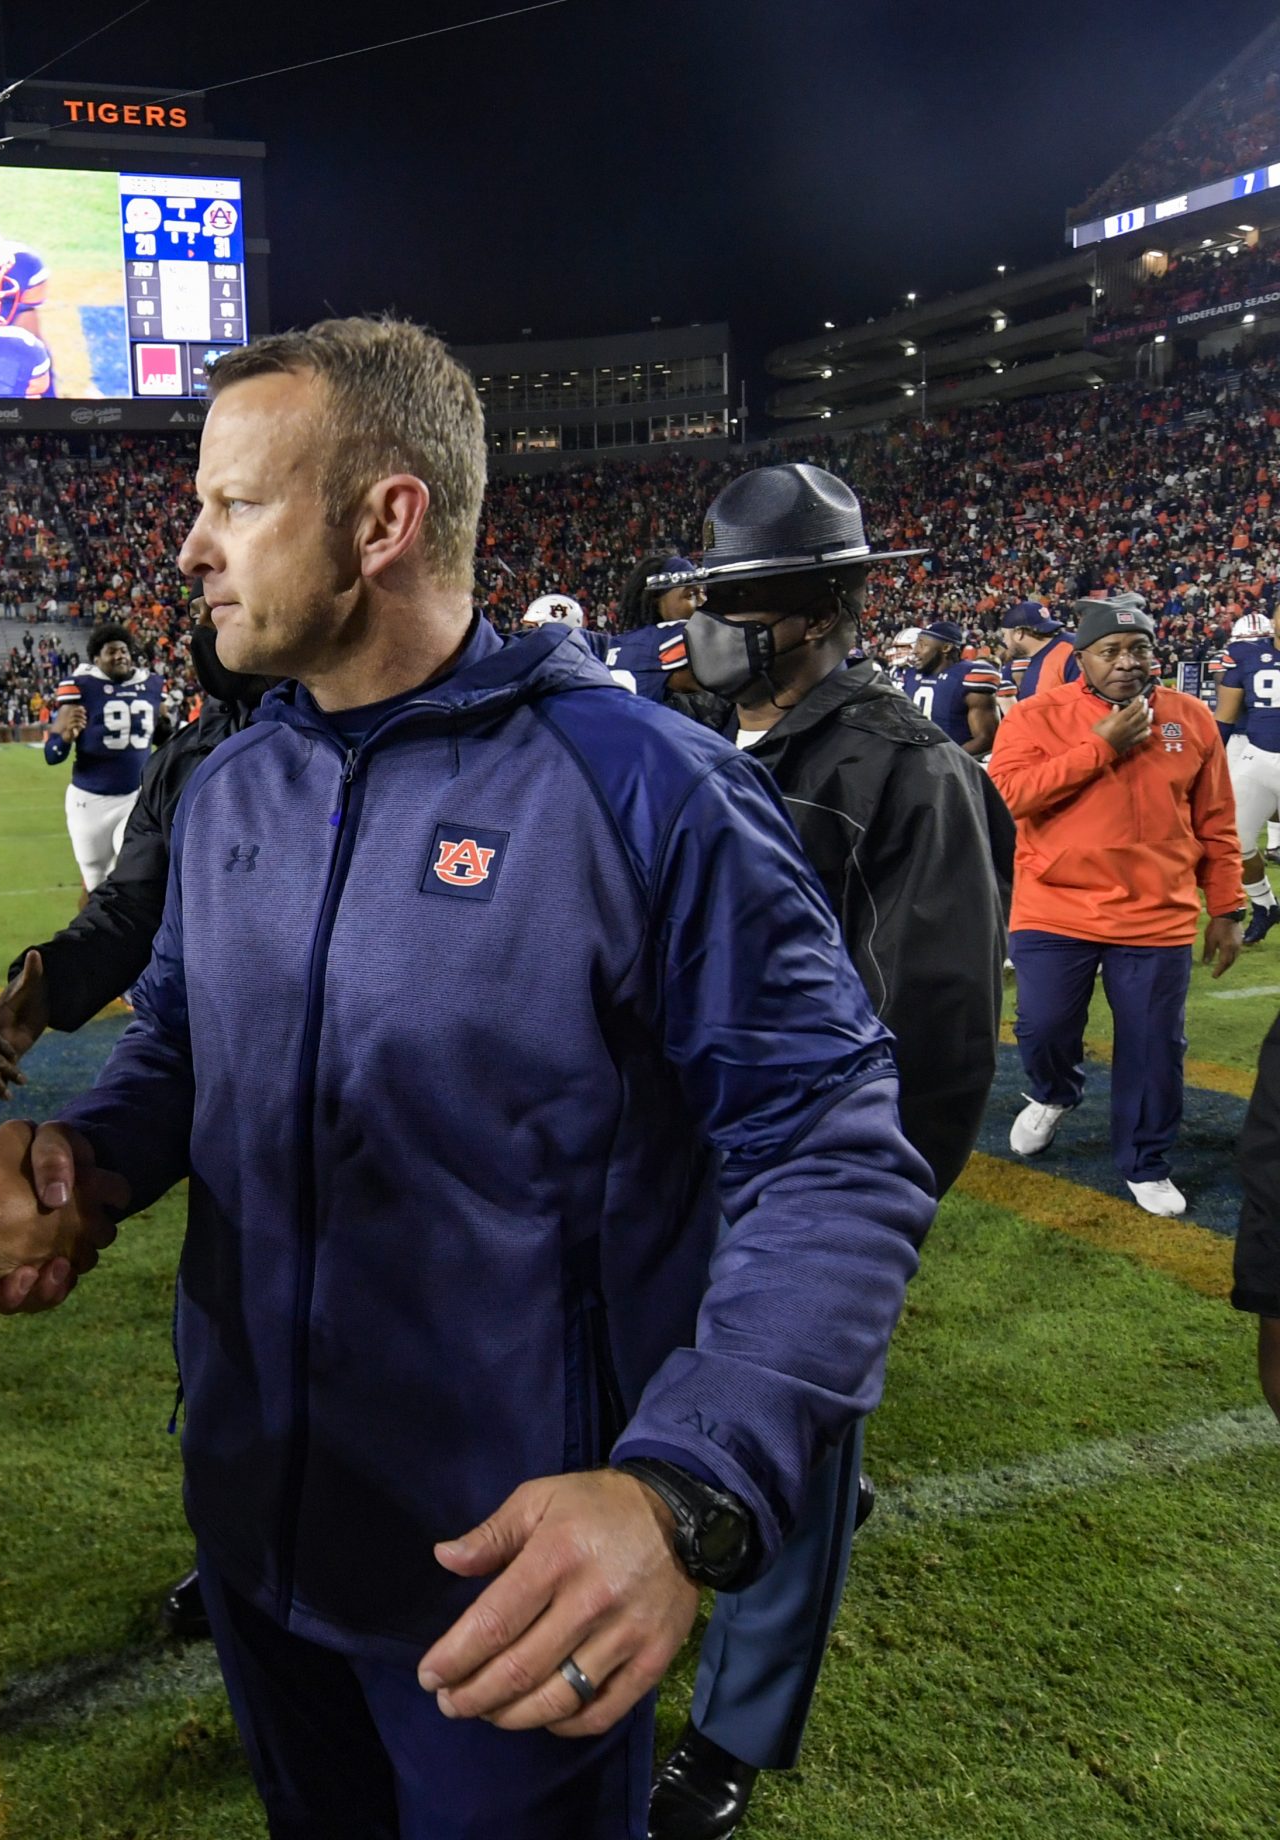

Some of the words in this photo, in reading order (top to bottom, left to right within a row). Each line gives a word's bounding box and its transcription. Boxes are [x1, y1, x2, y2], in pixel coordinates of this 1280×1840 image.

[63, 100, 187, 128] TIGERS
[1242, 172, 1255, 195] 7
[214, 236, 231, 258] 31
[1176, 301, 1243, 325] UNDEFEATED
[1138, 319, 1168, 334] FIELD
[102, 699, 155, 750] 93
